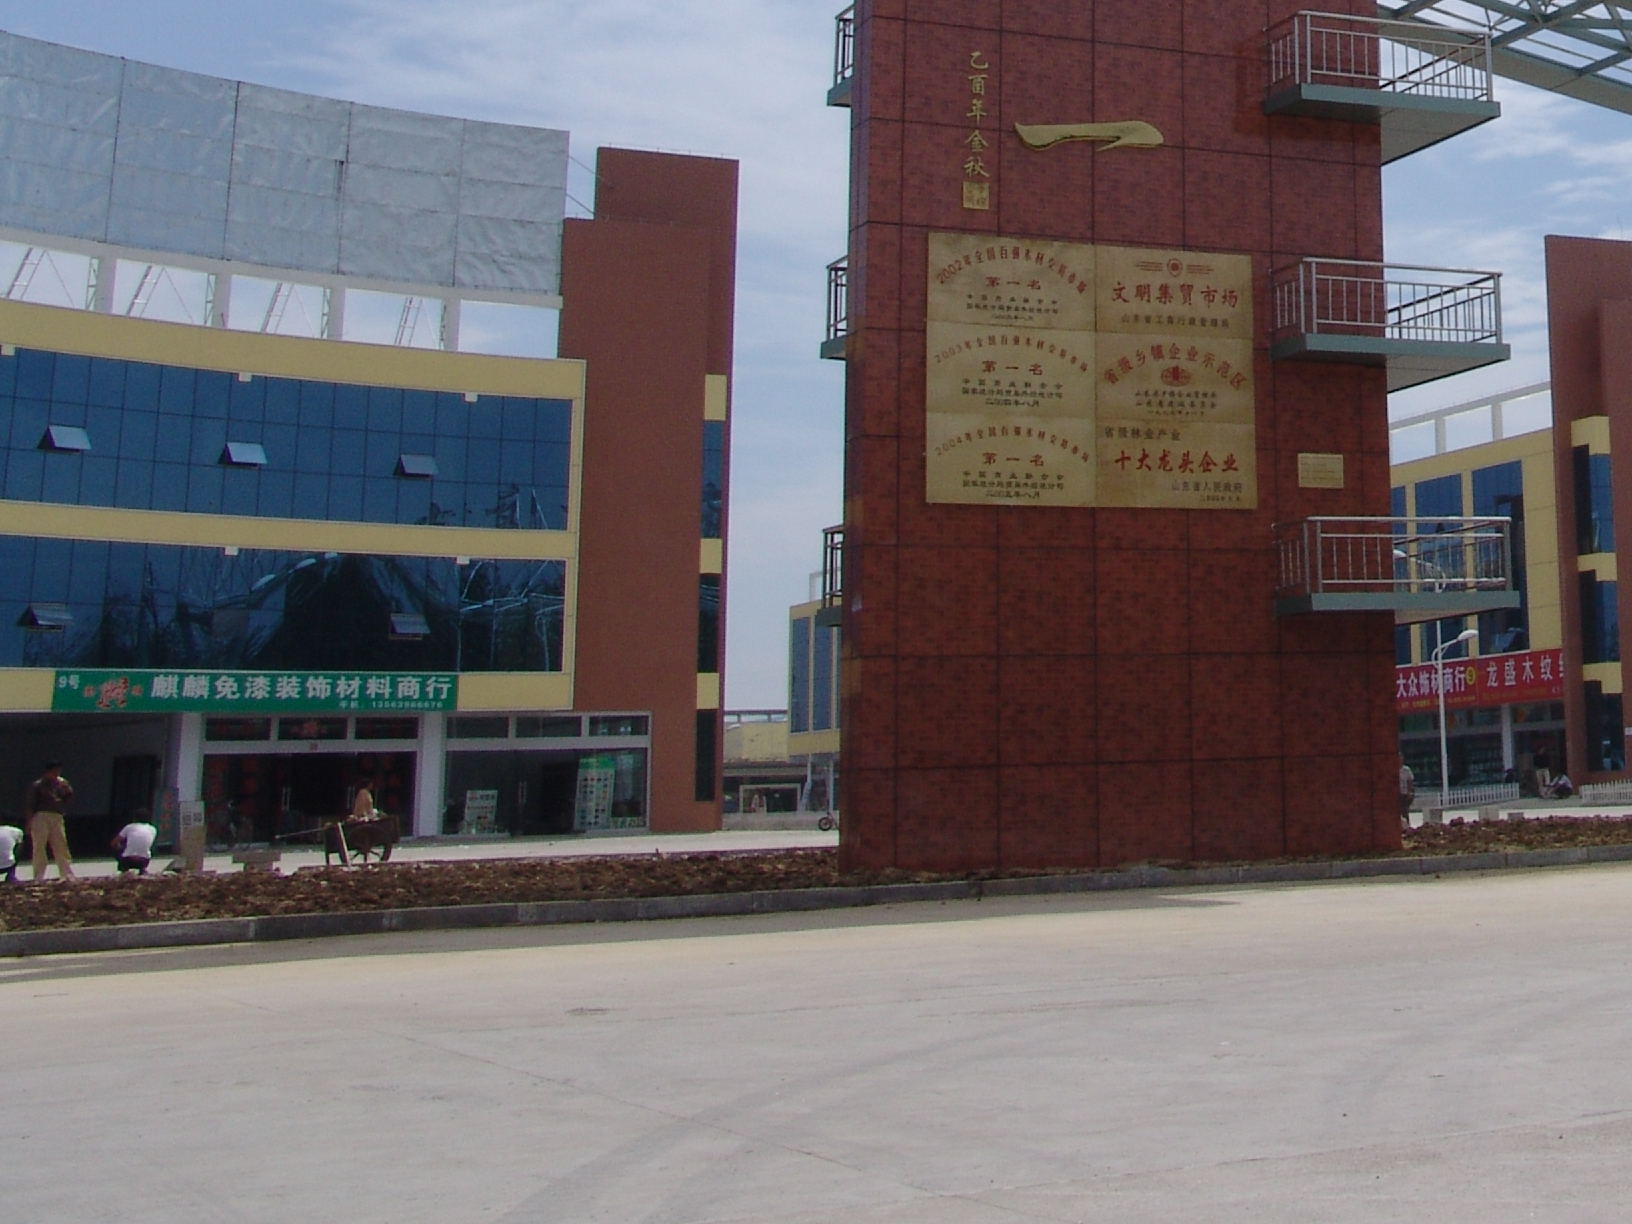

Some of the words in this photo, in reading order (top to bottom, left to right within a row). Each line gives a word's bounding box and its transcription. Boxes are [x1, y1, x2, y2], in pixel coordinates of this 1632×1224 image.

[963, 50, 990, 177] 乙酉年金秋
[985, 276, 1041, 290] 第一名
[1111, 280, 1239, 309] 文明集贸市场
[982, 360, 1043, 376] 第一名
[982, 452, 1044, 467] 第一名
[1114, 447, 1239, 474] 十大龙头企业
[151, 673, 453, 700] 麒麟免漆装饰材料商行
